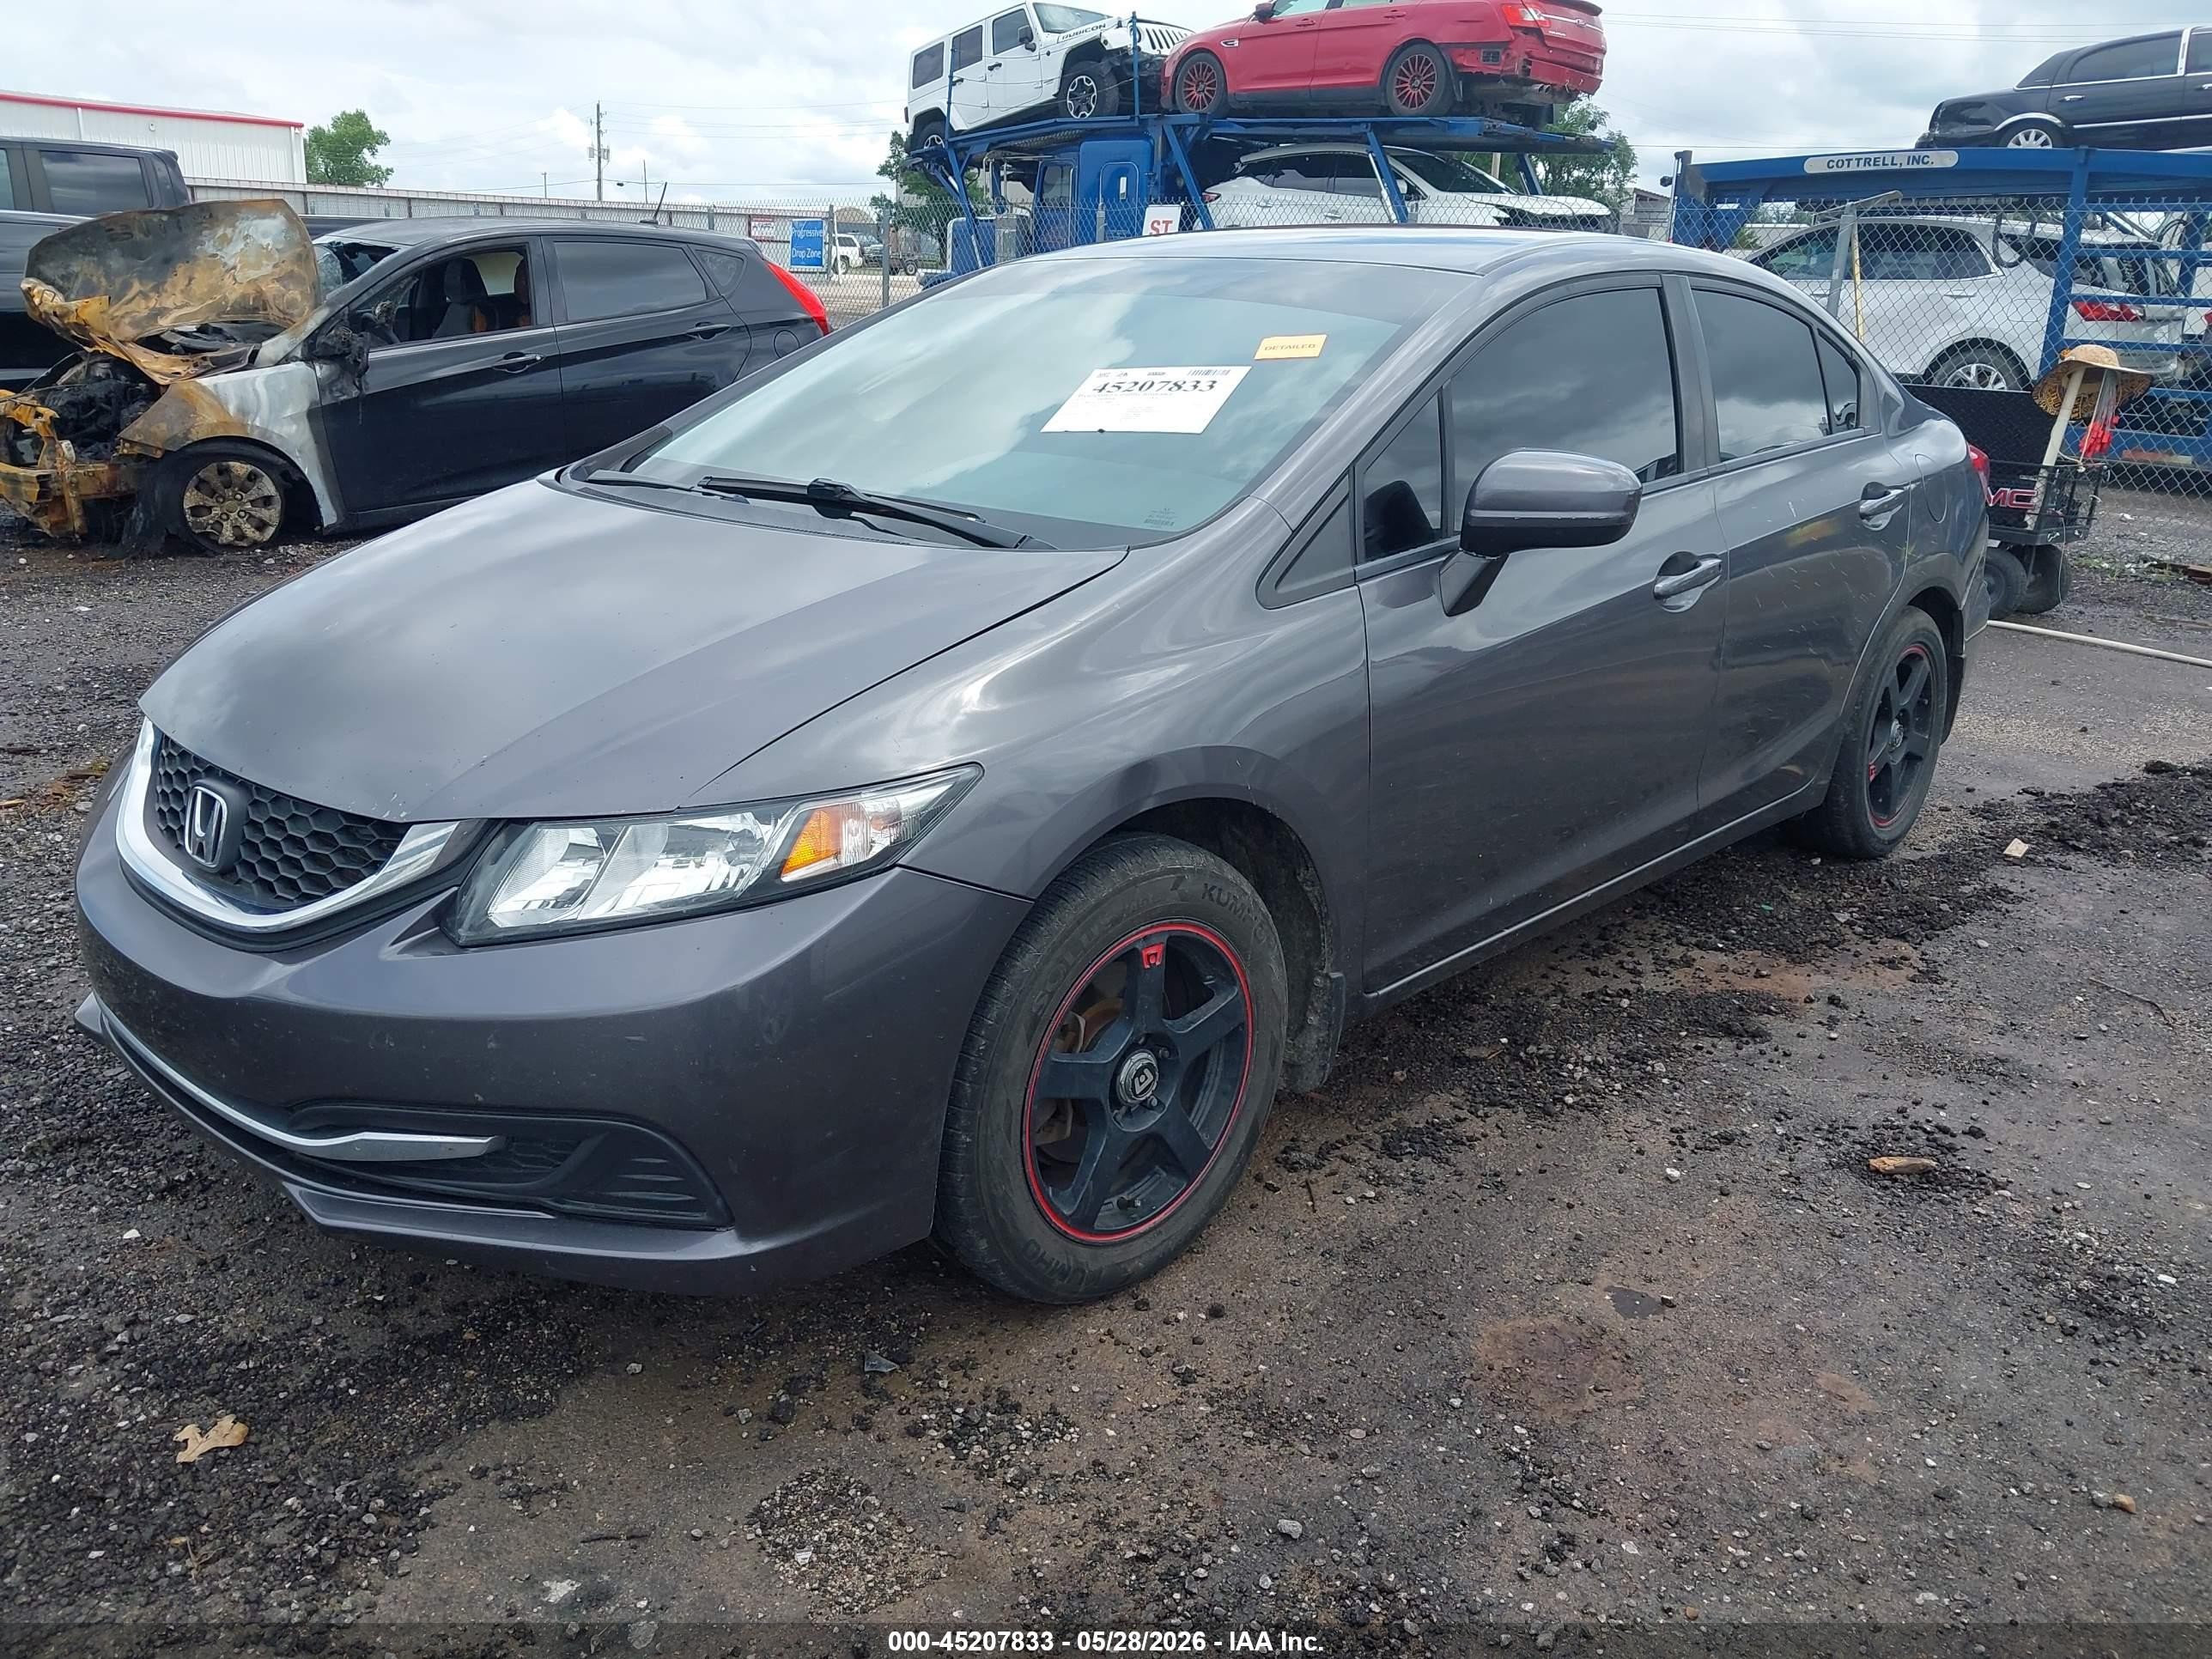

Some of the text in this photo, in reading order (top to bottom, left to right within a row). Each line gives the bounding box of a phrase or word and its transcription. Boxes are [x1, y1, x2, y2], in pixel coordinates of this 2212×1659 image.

[1062, 23, 1106, 40] RUBICON
[1826, 155, 1935, 169] COTTRELL, INC.
[792, 227, 823, 240] Progressive
[792, 247, 822, 259] Drop Zone
[1092, 380, 1218, 393] 45207833
[1986, 487, 2038, 509] MC
